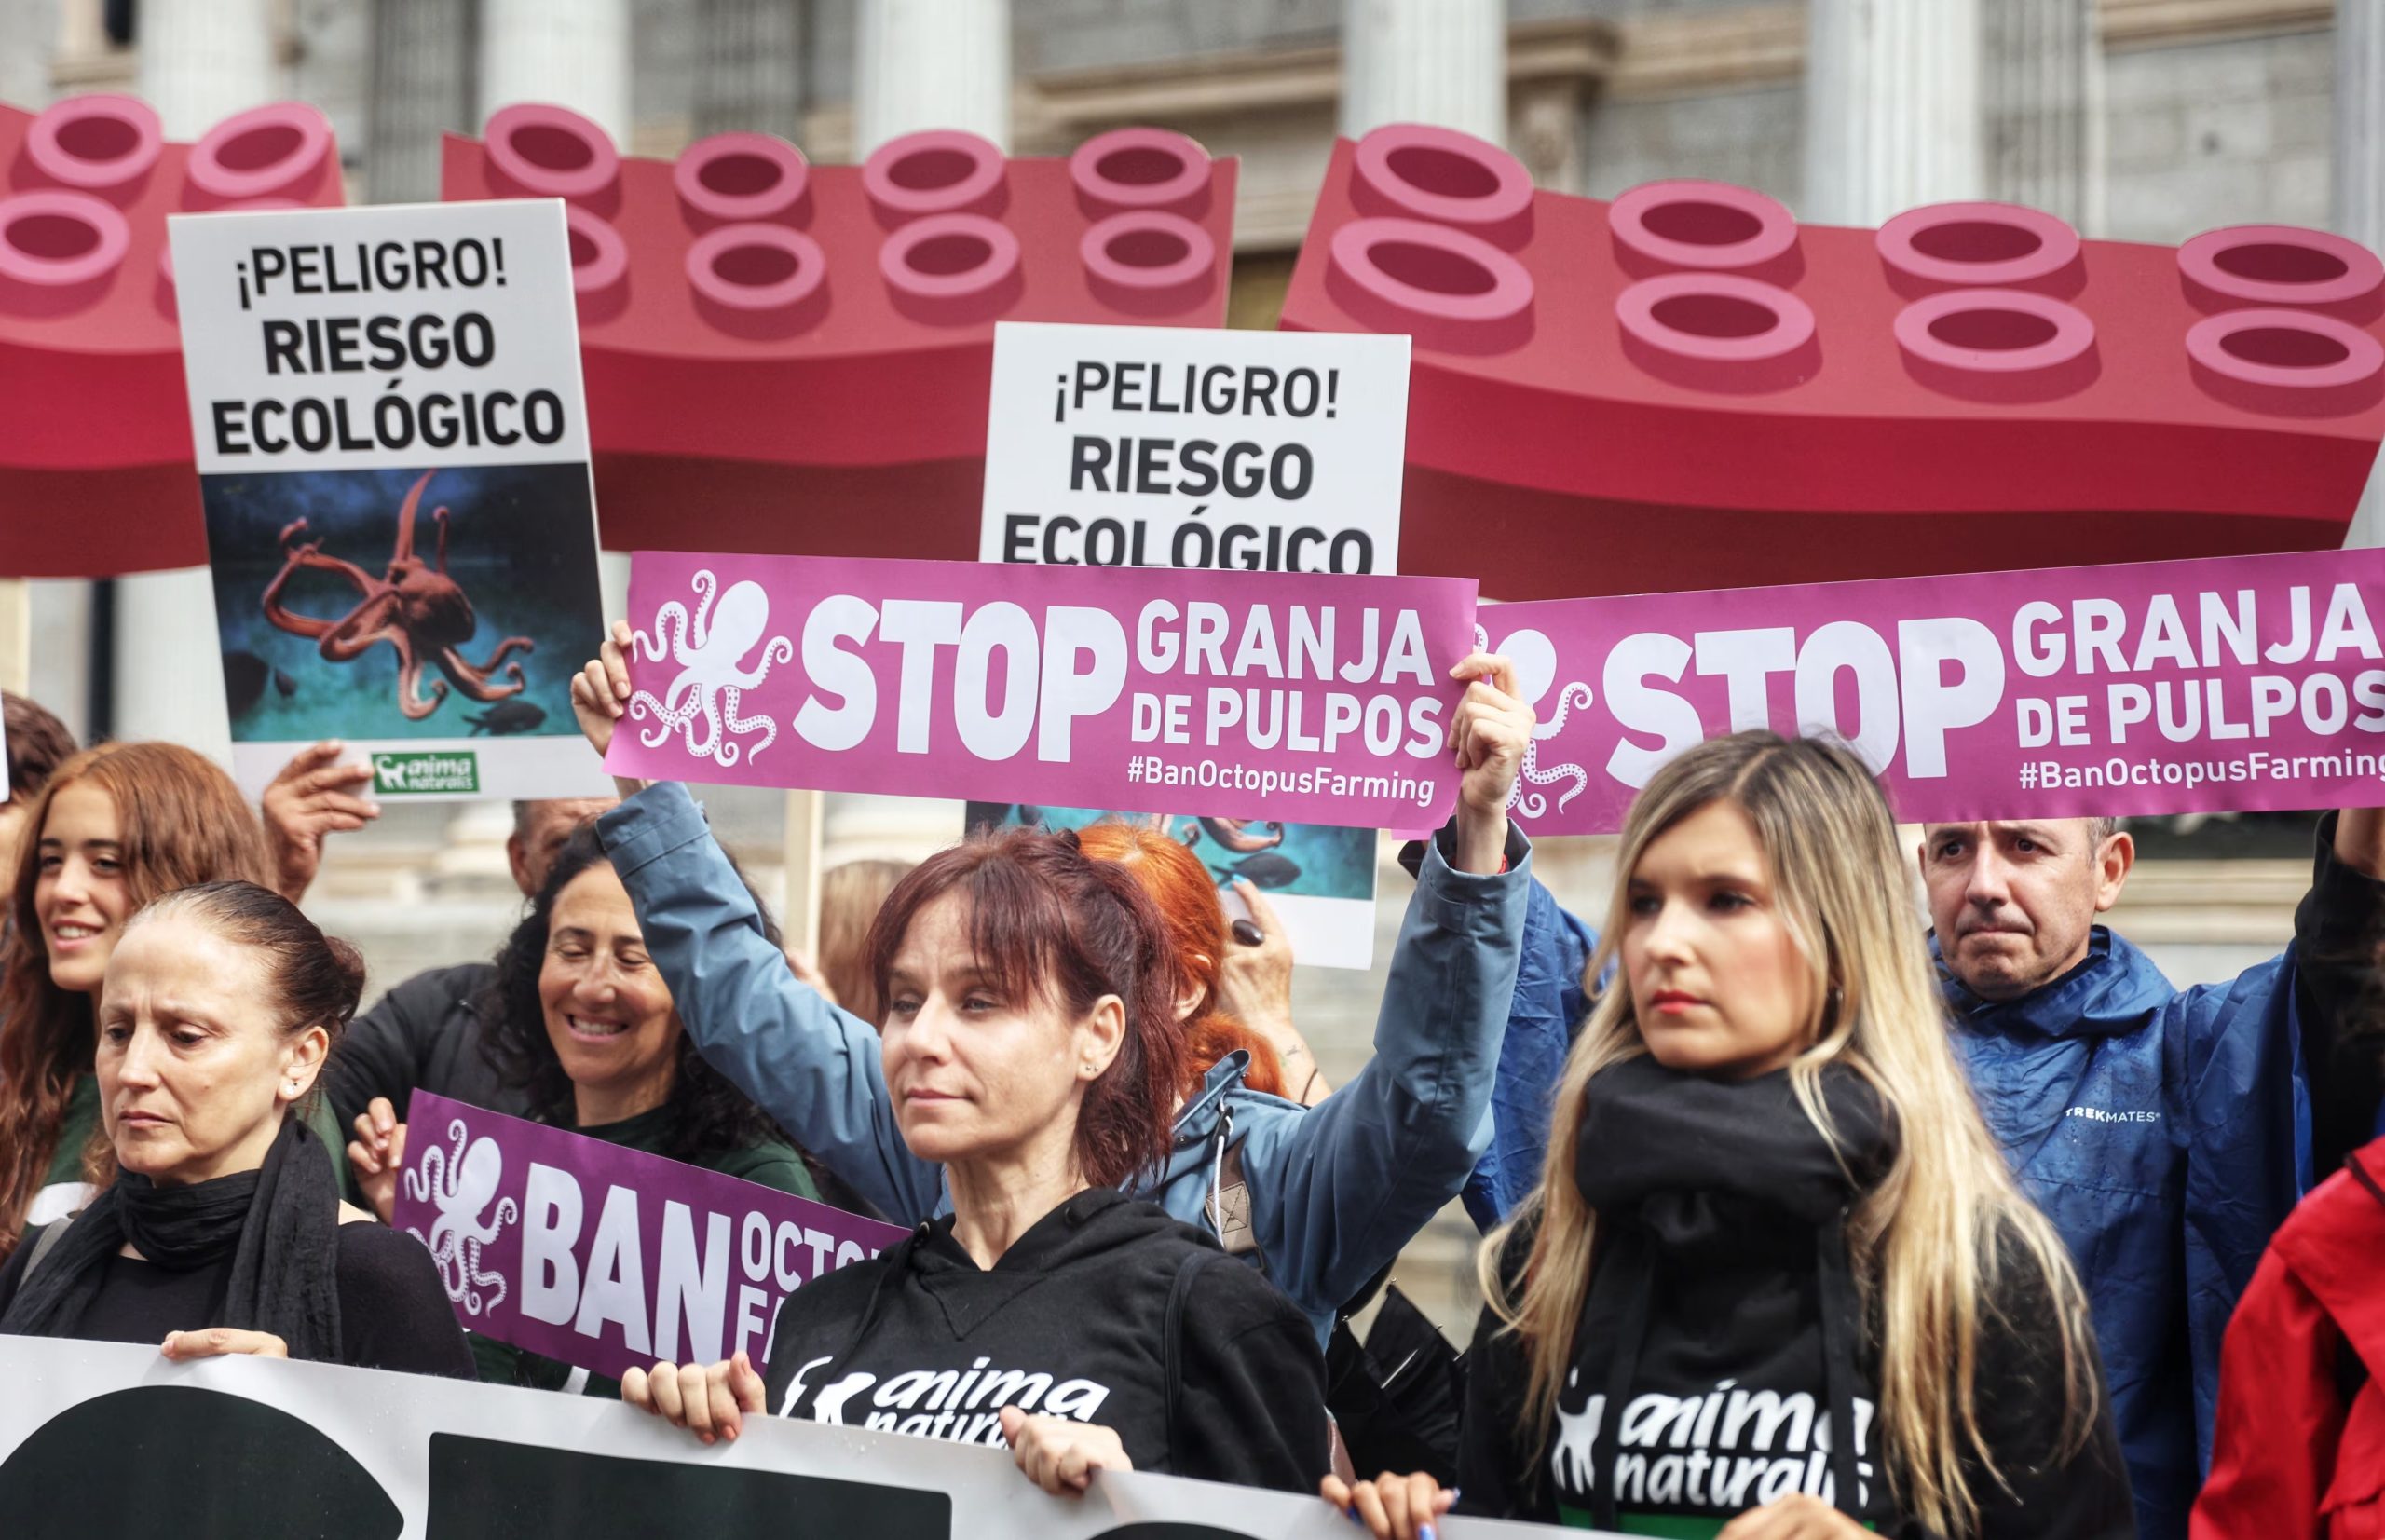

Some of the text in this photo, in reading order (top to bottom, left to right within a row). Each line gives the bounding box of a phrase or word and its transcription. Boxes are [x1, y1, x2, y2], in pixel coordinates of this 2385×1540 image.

[236, 238, 507, 310] ¡PELIGRO!
[262, 311, 495, 375] RIESGO
[211, 379, 566, 454] ECOLÓGICO
[1055, 360, 1339, 422] ¡PELIGRO!
[1070, 435, 1314, 500] RIESGO
[1002, 505, 1374, 574] ECOLÓGICO
[1136, 599, 1435, 687] GRANJA
[2012, 583, 2384, 677] GRANJA
[792, 594, 1128, 763] STOP
[1602, 617, 2006, 790] STOP
[2016, 669, 2385, 748] DE PULPOS
[1131, 687, 1443, 759] DE PULPOS
[407, 754, 471, 775] anima
[1127, 756, 1435, 807] #BanOctopusFarming
[520, 1162, 731, 1367] BAN
[873, 1356, 1110, 1423] anima
